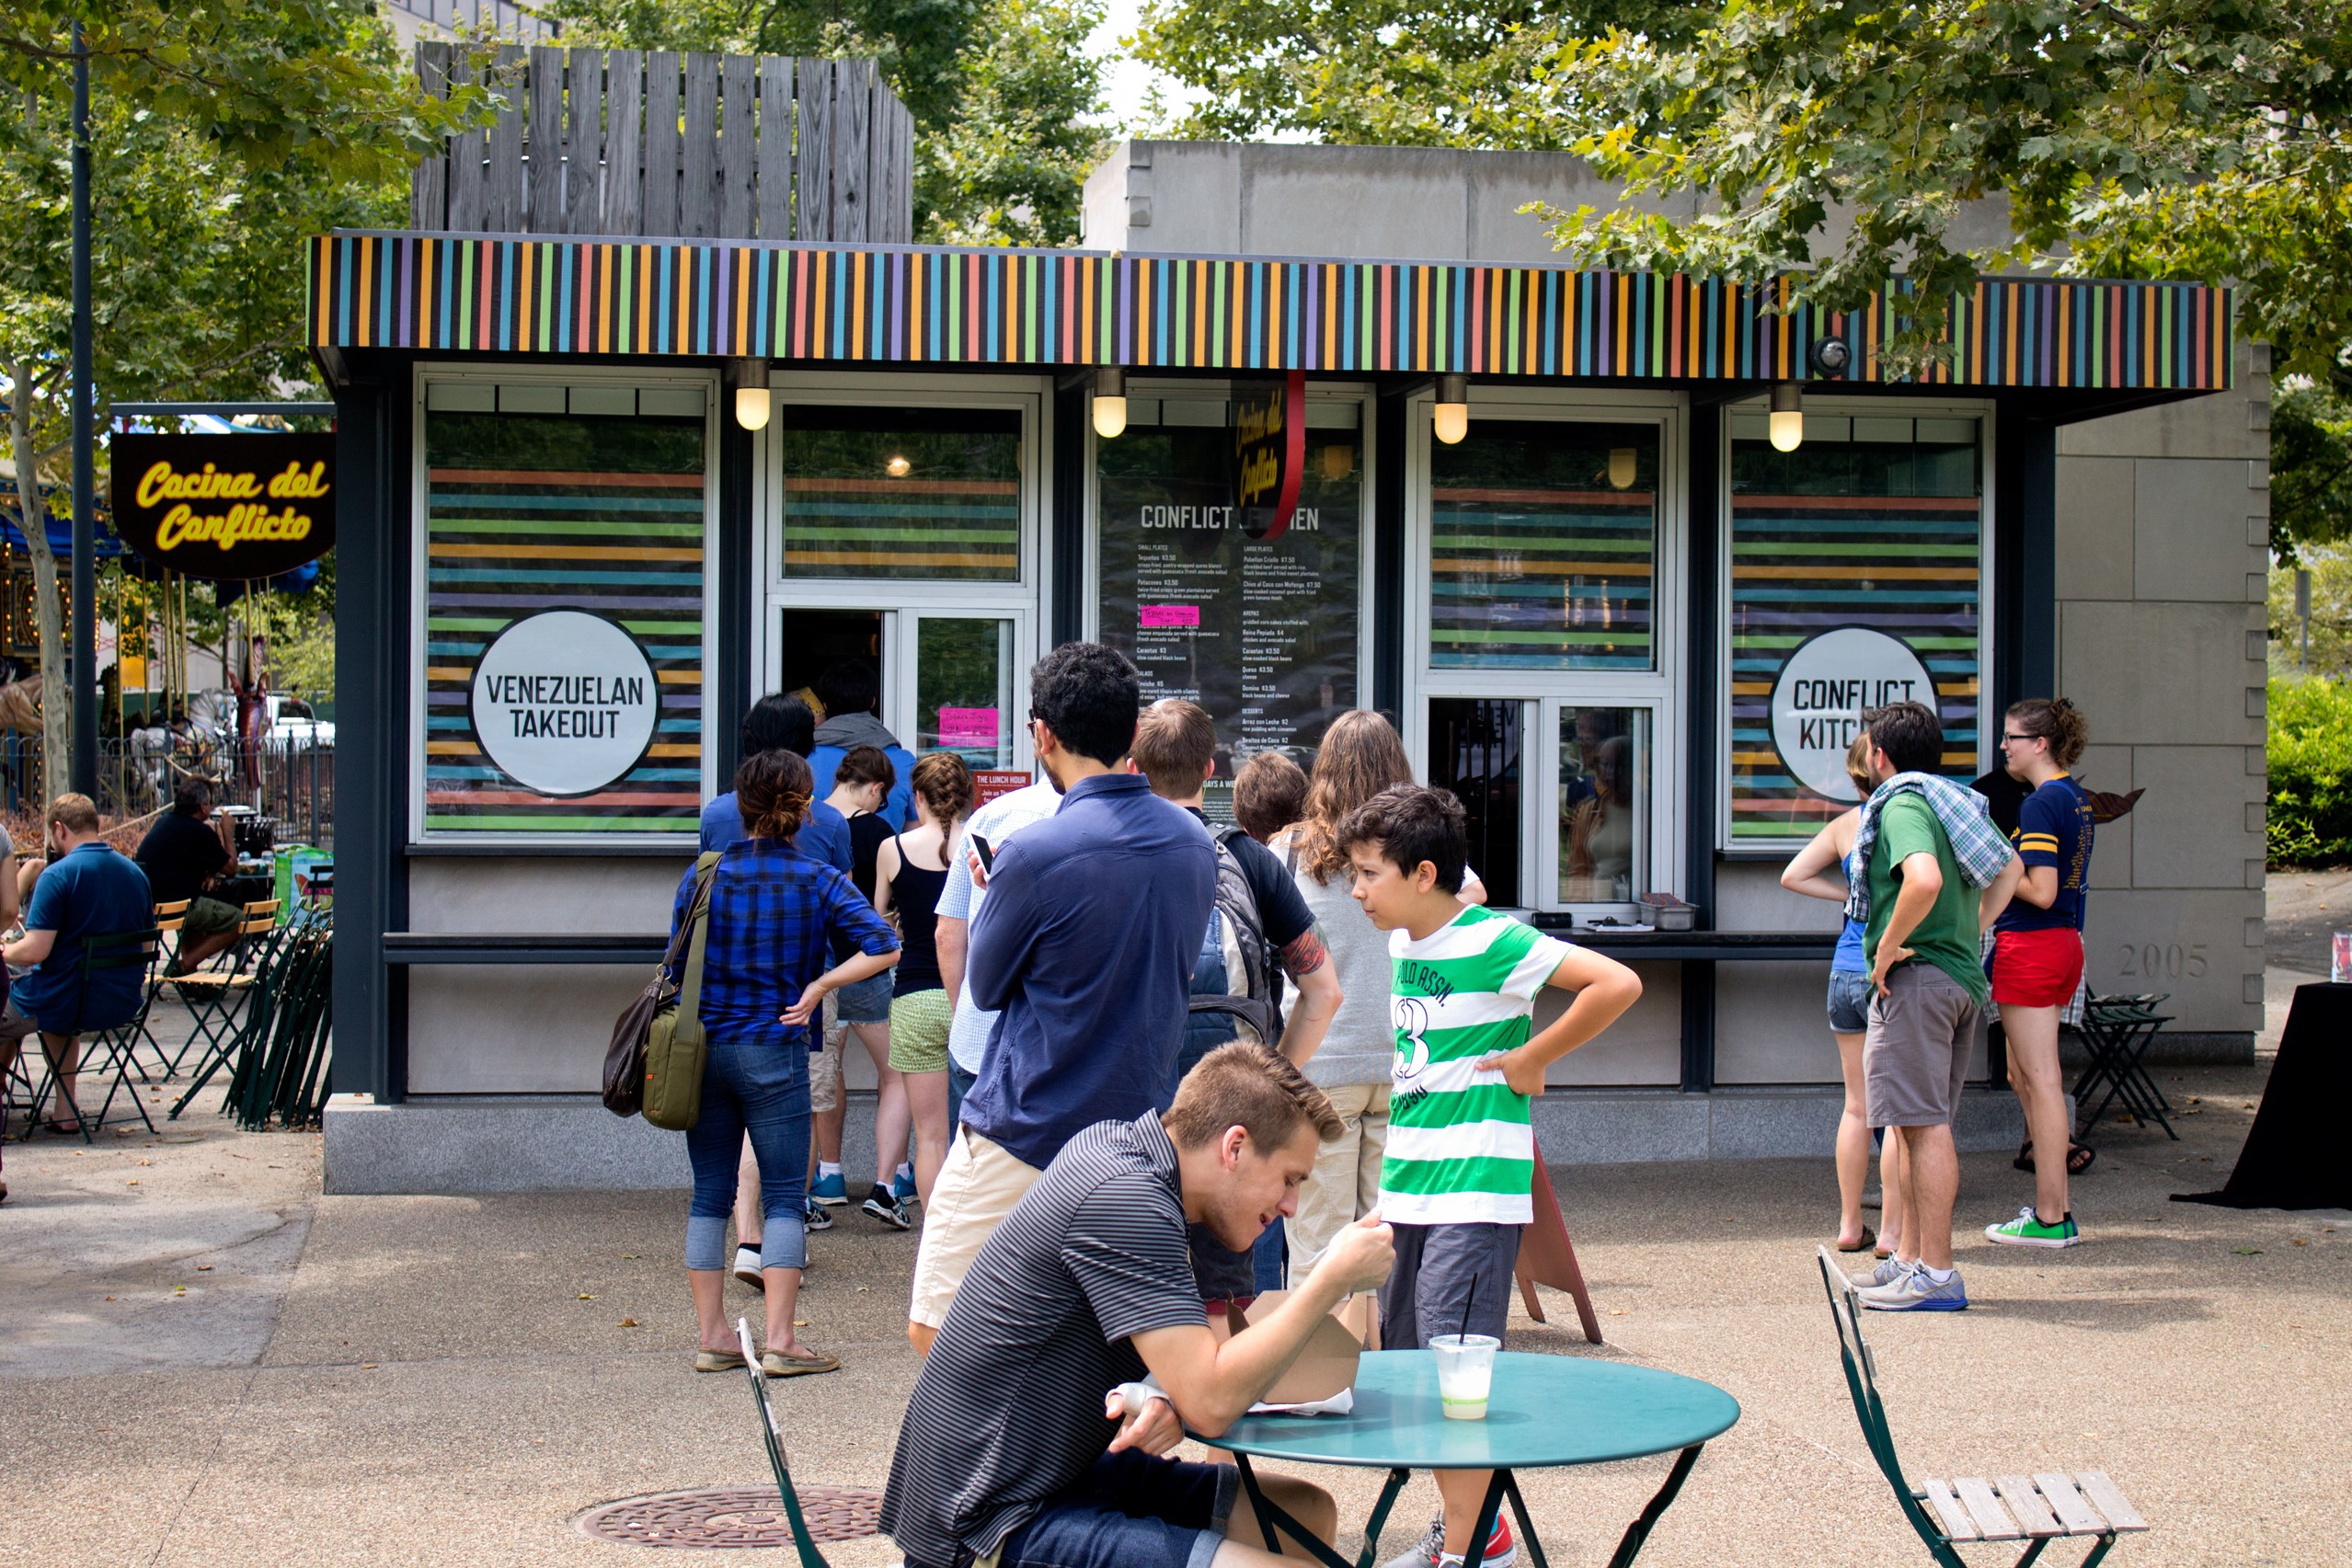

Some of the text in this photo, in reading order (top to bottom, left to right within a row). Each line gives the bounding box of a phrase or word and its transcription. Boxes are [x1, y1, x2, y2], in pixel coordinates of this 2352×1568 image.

[136, 460, 330, 508] Cocina del
[155, 503, 312, 551] Conflicto
[1141, 505, 1233, 528] CONFLICT
[486, 675, 643, 704] VENEZUELAN
[1793, 680, 1915, 710] CONFLICT
[510, 709, 620, 738] TAKEOUT
[1800, 718, 1866, 749] KITC
[989, 776, 1008, 784] LUNCH
[1010, 776, 1026, 784] HOUR
[2118, 943, 2208, 978] 2005
[1417, 966, 1454, 1007] ASSN.
[1395, 998, 1430, 1079] 3
